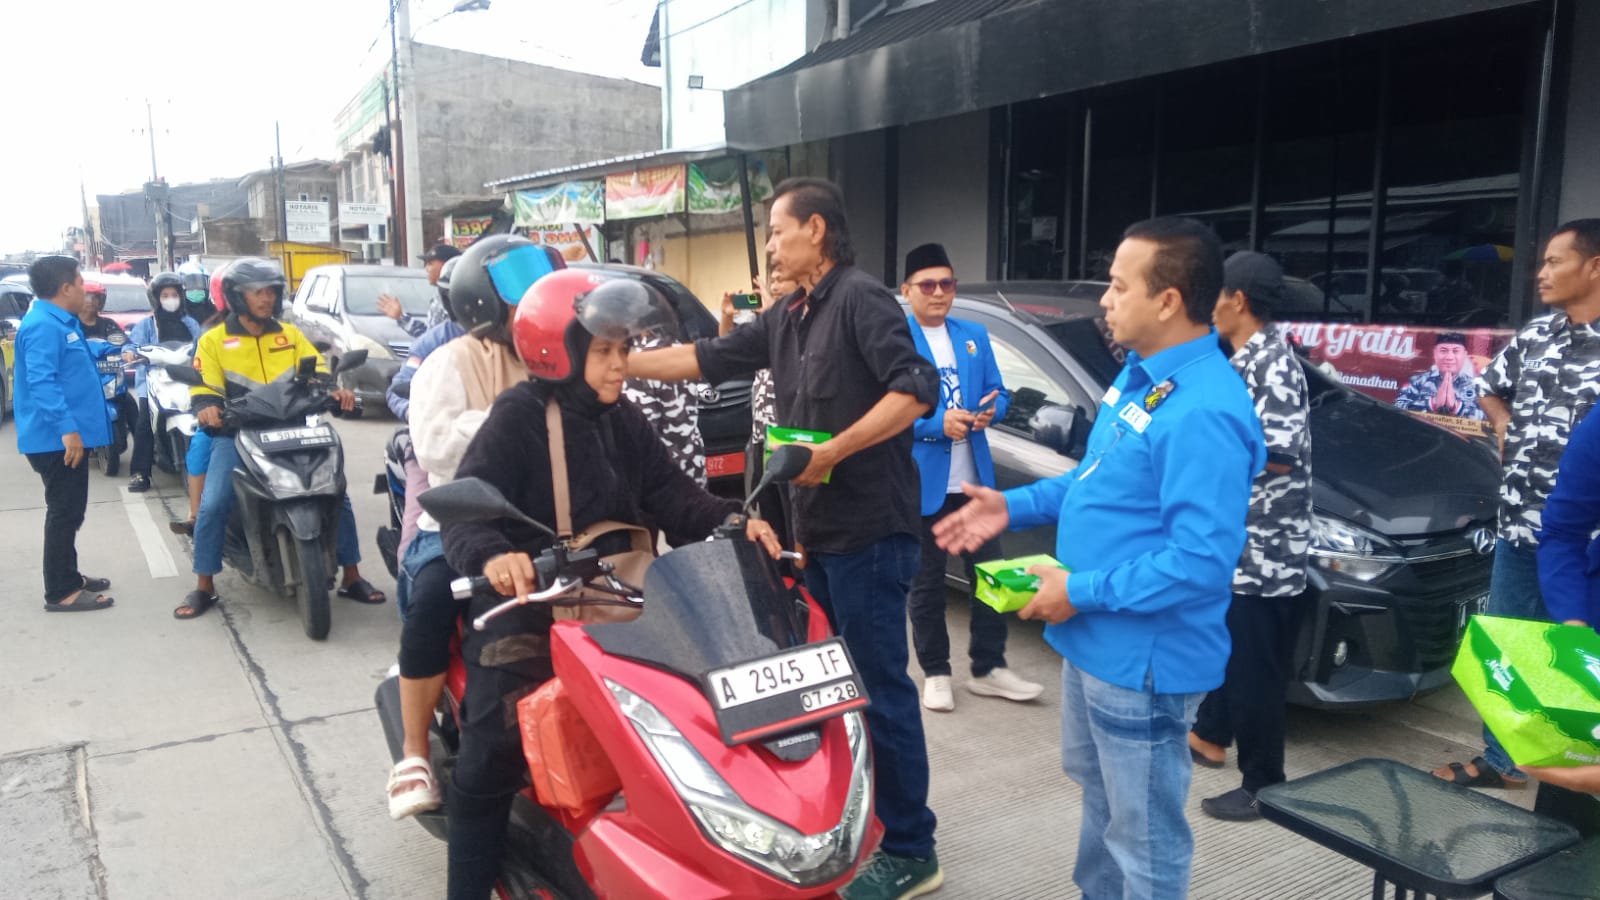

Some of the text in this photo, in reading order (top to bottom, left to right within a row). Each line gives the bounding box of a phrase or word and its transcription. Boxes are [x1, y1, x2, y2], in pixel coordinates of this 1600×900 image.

[1325, 324, 1415, 359] Gratis
[1339, 371, 1399, 390] amadhan
[720, 649, 840, 703] A 2945 IF
[777, 732, 818, 748] HONDA
